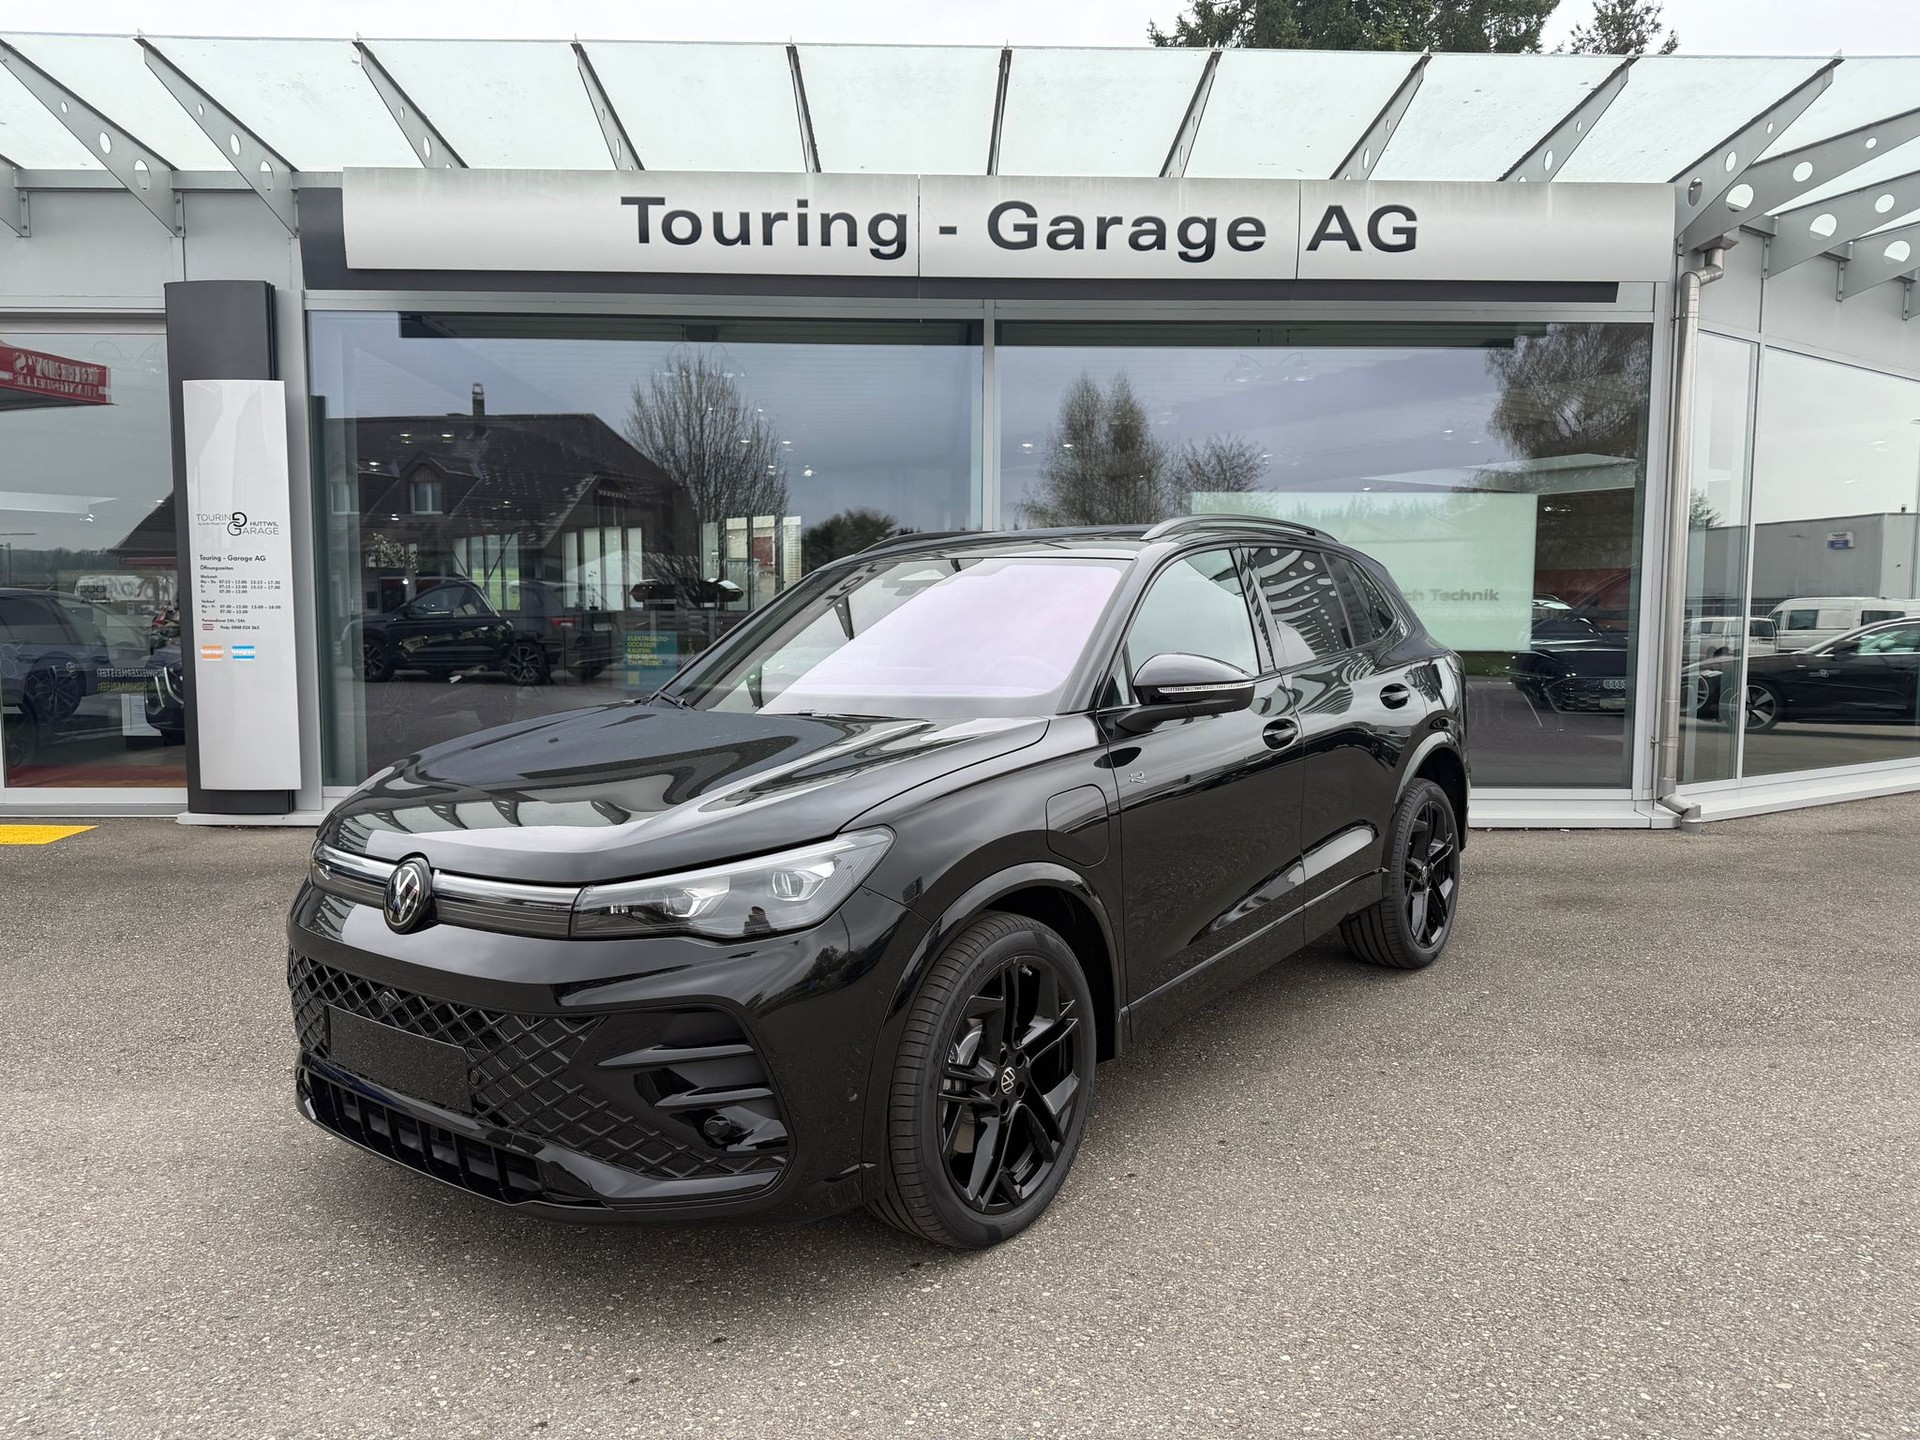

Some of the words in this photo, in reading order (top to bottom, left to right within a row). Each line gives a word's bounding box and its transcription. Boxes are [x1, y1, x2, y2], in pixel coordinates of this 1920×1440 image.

[621, 196, 907, 261] Touring
[939, 226, 957, 235] -
[987, 201, 1266, 264] Garage
[1306, 204, 1417, 253] AG
[200, 554, 221, 562] Touring
[227, 554, 253, 562] Garage
[1430, 589, 1499, 601] Technik
